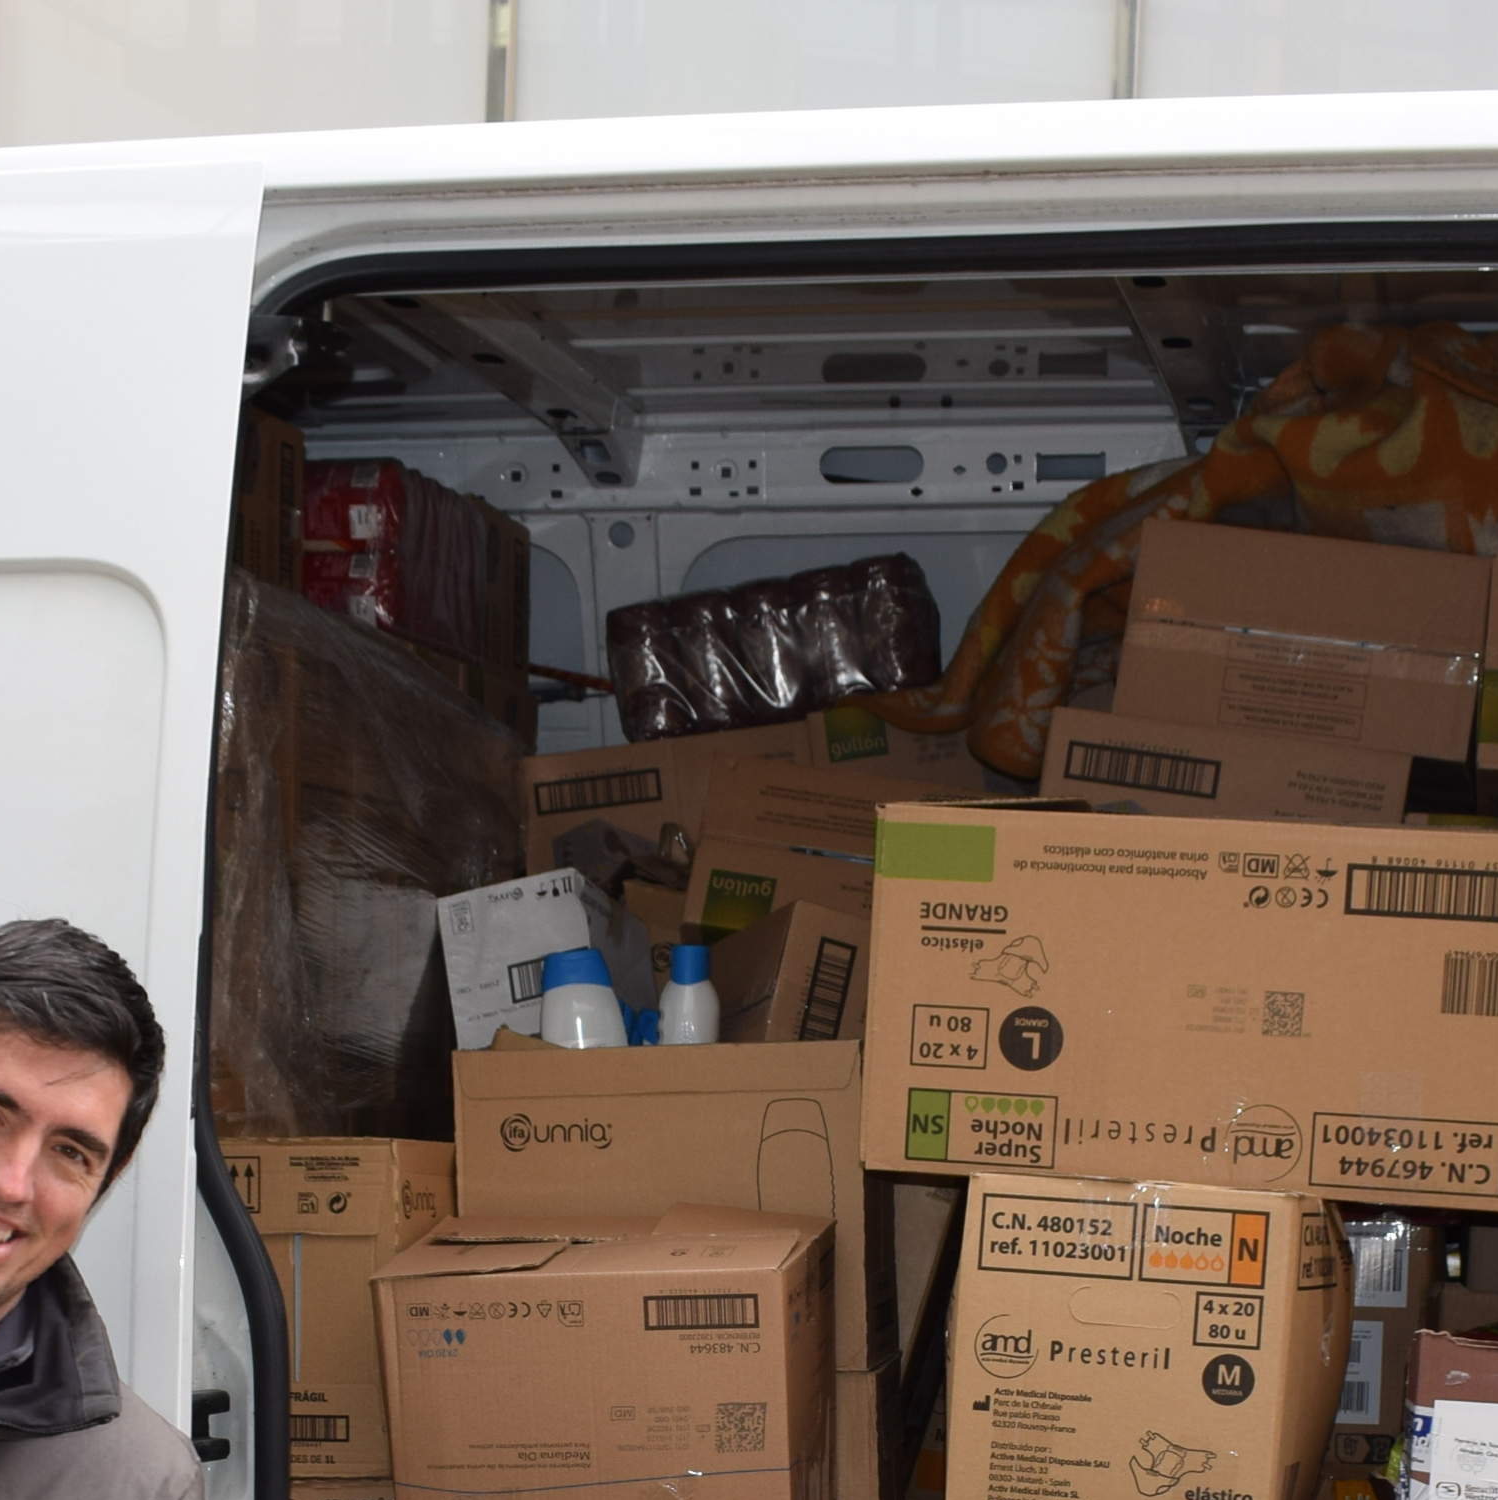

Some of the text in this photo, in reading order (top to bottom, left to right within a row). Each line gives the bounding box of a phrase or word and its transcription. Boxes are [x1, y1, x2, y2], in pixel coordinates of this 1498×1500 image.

[832, 733, 885, 758] gullón
[1043, 845, 1208, 863] orina anatómico con elásticos
[1013, 861, 1207, 880] Absorbentes para Incontinencia de
[1247, 858, 1276, 873] MD
[712, 877, 772, 897] gullón
[920, 902, 1008, 922] GRANDE
[921, 936, 984, 953] elástico
[929, 1015, 972, 1032] 80 u
[1014, 1017, 1049, 1027] GRANDE
[919, 1042, 978, 1060] 4 x 20
[1022, 1031, 1040, 1059] L
[911, 1113, 944, 1135] SN
[970, 1119, 1043, 1141] Noche
[1063, 1118, 1217, 1153] Presteril
[1322, 1124, 1493, 1154] ref. 11034001
[974, 1140, 1042, 1164] Super
[1234, 1136, 1294, 1164] amd
[1339, 1156, 1491, 1184] C.N. 467944
[992, 1211, 1113, 1236] C.N. 480152
[1155, 1224, 1223, 1248] Noche
[990, 1239, 1127, 1263] ref. 11023001
[1237, 1237, 1259, 1262] N
[410, 1306, 429, 1317] MD
[1203, 1299, 1255, 1317] 4 x 20
[1208, 1323, 1246, 1340] 80 u
[690, 1342, 760, 1354] C.N. 483644
[980, 1329, 1032, 1354] amd
[1050, 1340, 1170, 1370] Presteril
[1217, 1364, 1240, 1386] M
[994, 1388, 1092, 1402] Activ Medical Disposable
[1211, 1388, 1243, 1397] MEDIANA
[994, 1398, 1010, 1406] Parc
[614, 1410, 633, 1418] MD
[993, 1409, 1060, 1421] Rue pablo Picasso
[991, 1441, 1033, 1452] Distribuido
[311, 1455, 322, 1463] DE
[518, 1452, 591, 1462] Mediana Día
[990, 1452, 1110, 1468] Active Medical Disposable SAU
[988, 1484, 1008, 1493] Activ
[1010, 1487, 1040, 1495] Medical
[1050, 1478, 1070, 1487] Spain
